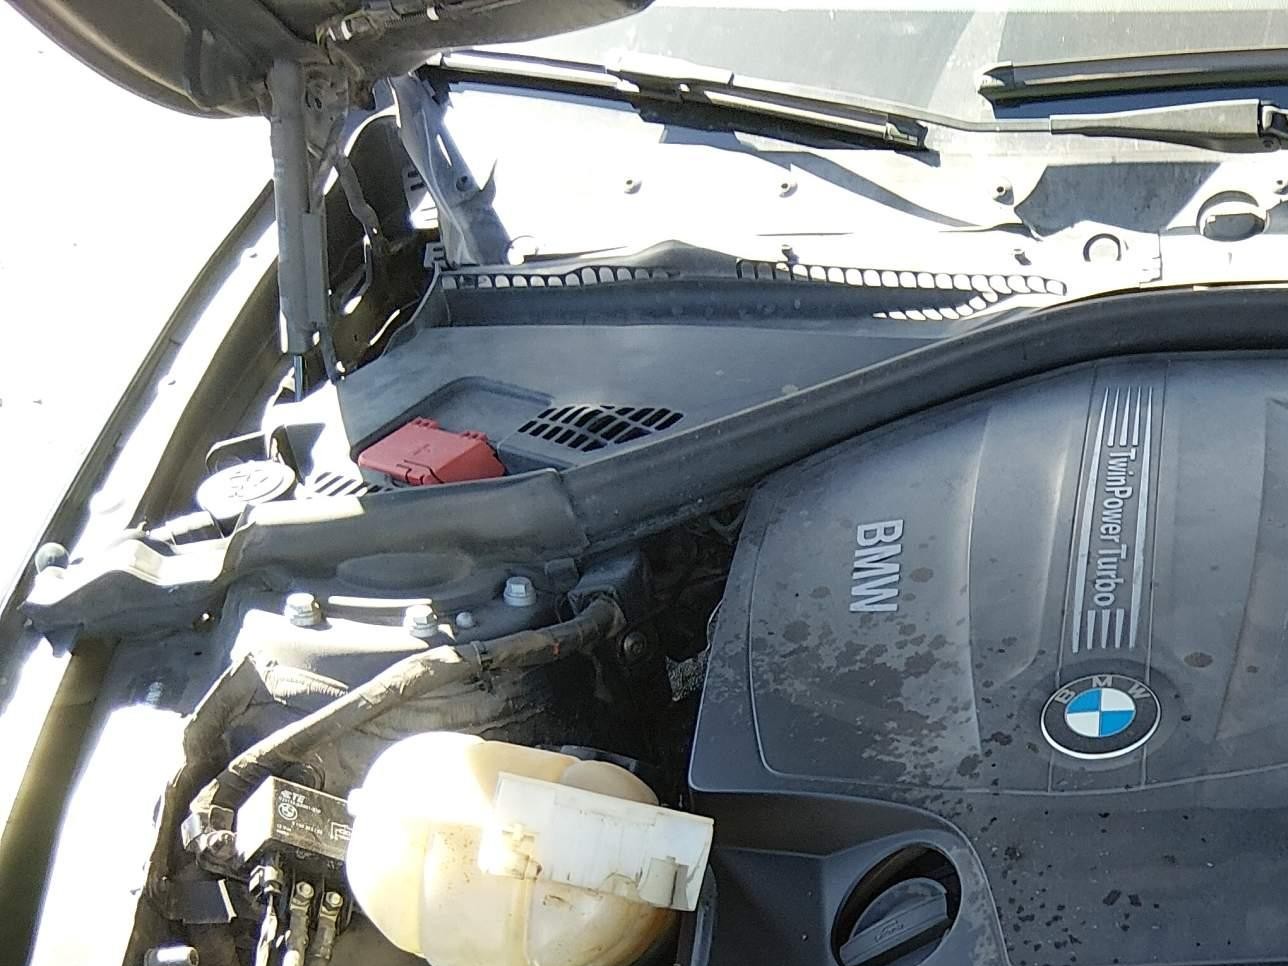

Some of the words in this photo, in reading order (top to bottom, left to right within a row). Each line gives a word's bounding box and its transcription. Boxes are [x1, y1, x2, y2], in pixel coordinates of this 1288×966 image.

[1100, 448, 1137, 541] TwinPower
[849, 519, 904, 612] BMW
[1093, 544, 1127, 607] Turbo
[1054, 675, 1151, 705] BMW
